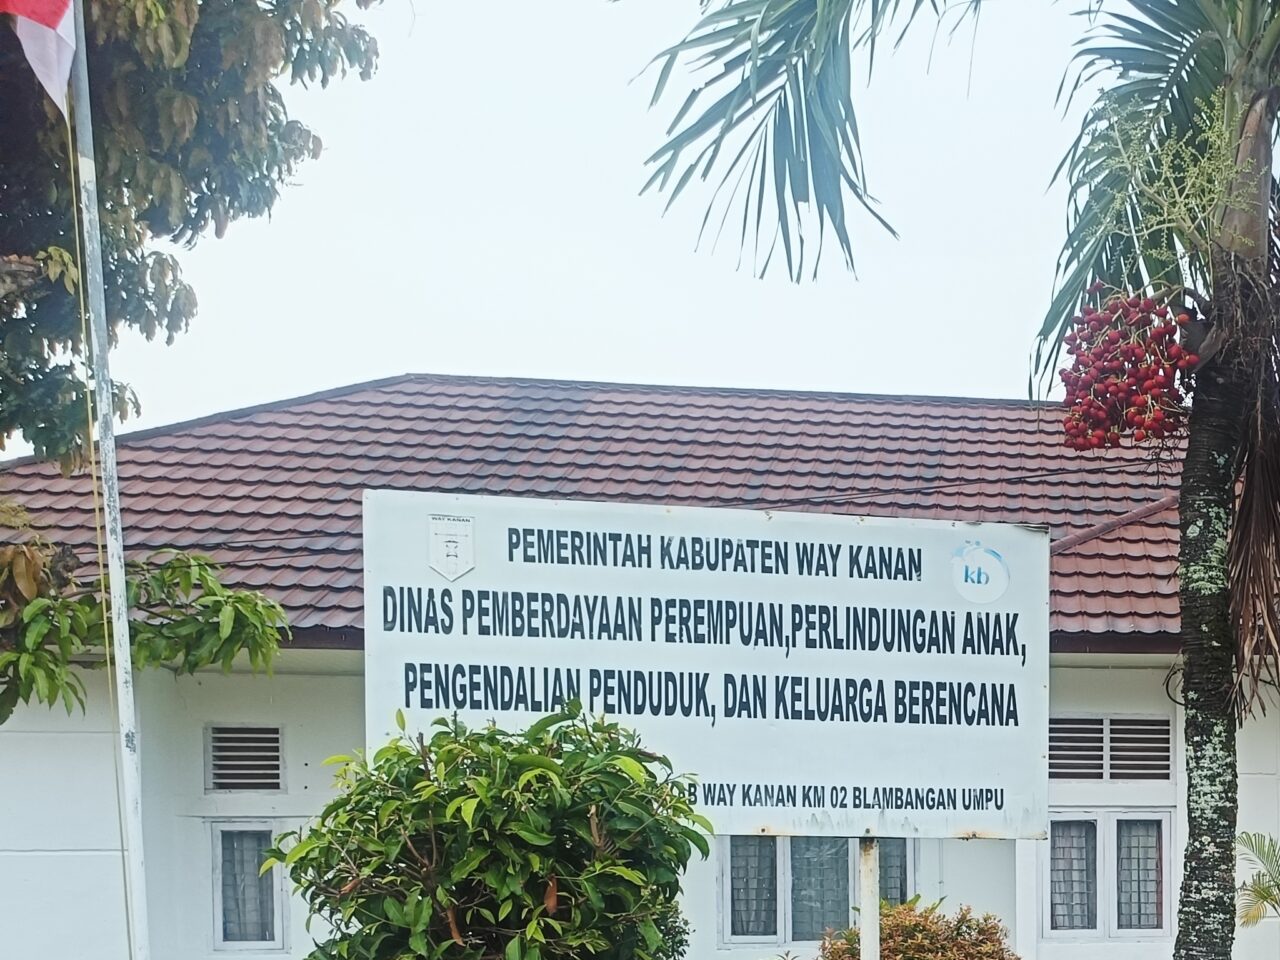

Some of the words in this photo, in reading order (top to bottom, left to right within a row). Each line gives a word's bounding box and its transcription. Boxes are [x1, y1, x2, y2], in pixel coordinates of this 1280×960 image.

[507, 527, 652, 569] PEMERINTAH
[660, 535, 789, 575] KABUPATEN
[795, 541, 842, 578] WAY
[848, 544, 922, 582] KANAN
[964, 565, 990, 585] kb
[382, 585, 454, 635] DINAS
[461, 589, 643, 642] PEMBERDAYAAN
[961, 611, 1027, 668] ANAK,
[404, 662, 581, 712] PENGENDALIAN
[588, 668, 716, 727] PENDUDUK,
[723, 673, 767, 720] DAN
[774, 675, 888, 723] KELUARGA
[894, 679, 1019, 727] BERENCANA
[702, 783, 737, 807] WAY
[741, 783, 797, 808] KANAN
[801, 785, 825, 808] KM
[830, 785, 848, 809] 02
[852, 786, 957, 811] BLAMBANGAN
[961, 788, 1004, 811] UMPU
